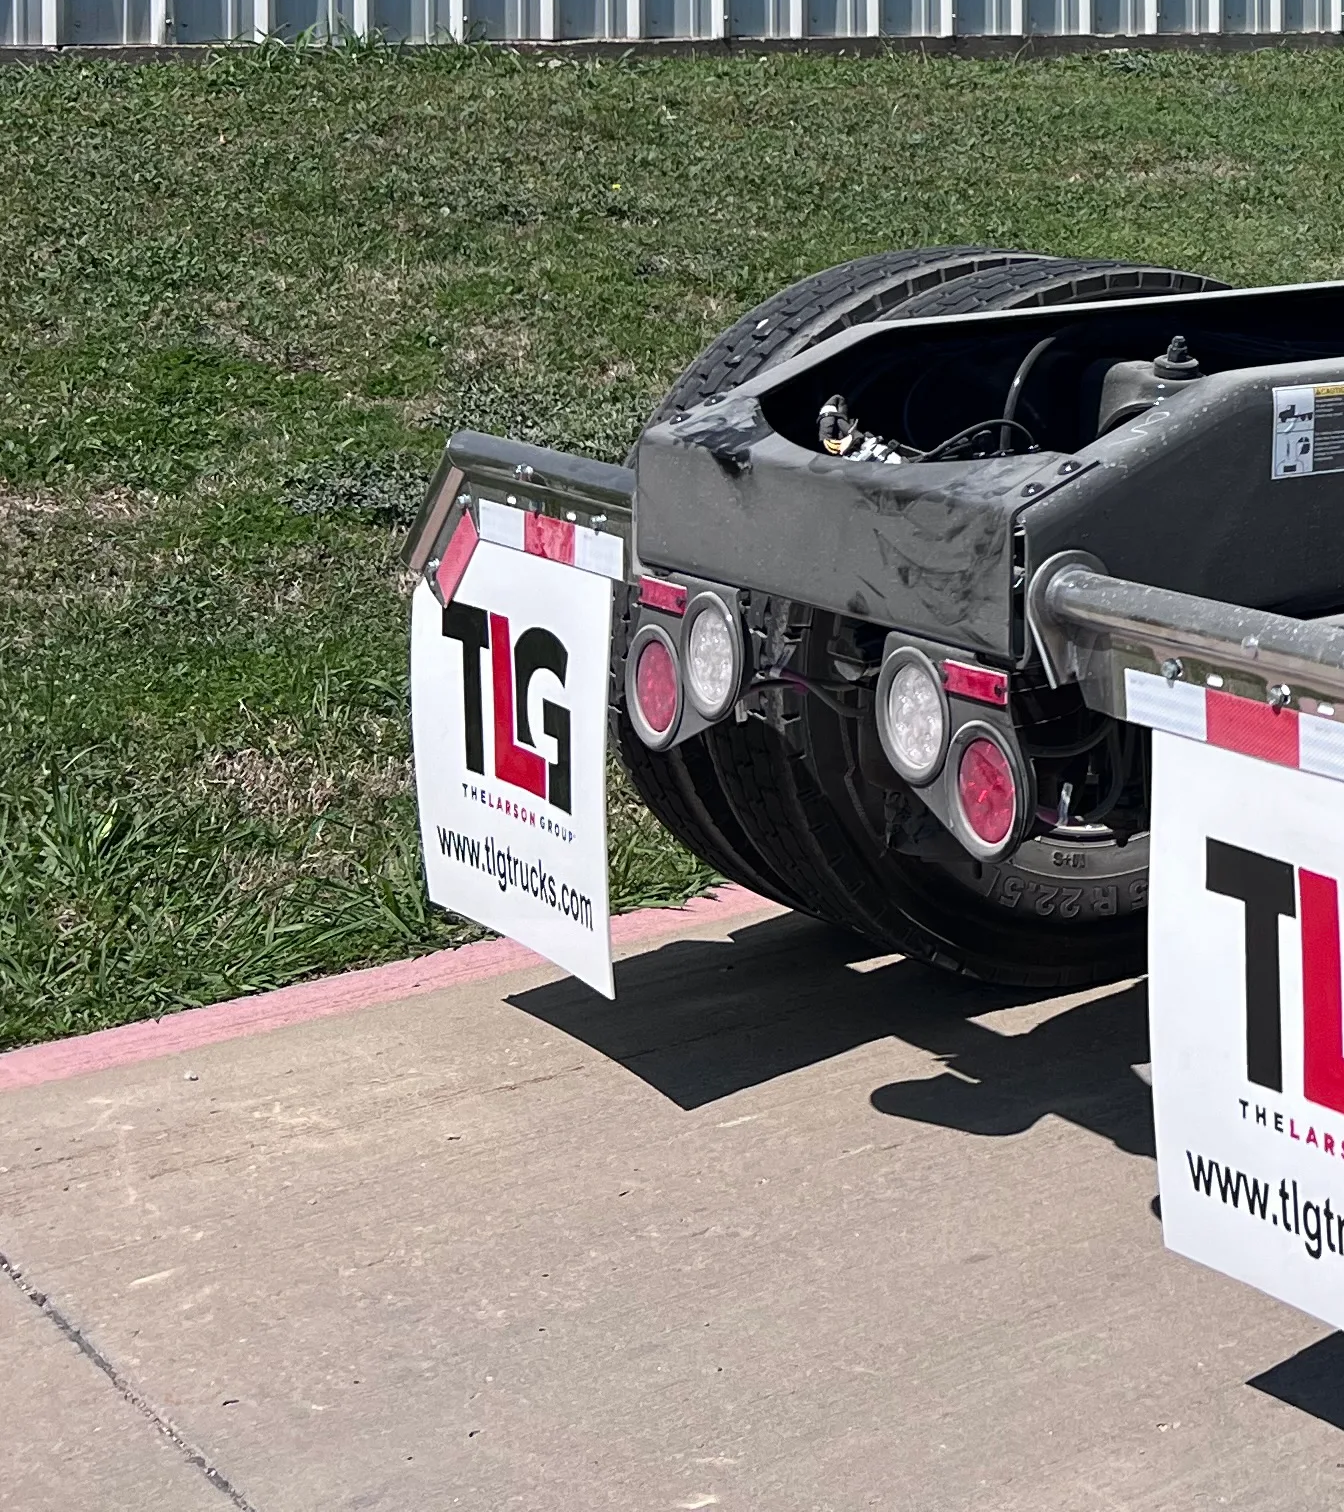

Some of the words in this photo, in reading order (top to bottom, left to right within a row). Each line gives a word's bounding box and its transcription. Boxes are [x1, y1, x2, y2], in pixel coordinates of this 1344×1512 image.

[441, 600, 572, 816] TLG
[539, 815, 573, 844] GROUP
[436, 825, 594, 931] www.tlgtrucks.com
[1052, 851, 1086, 869] M+S
[999, 875, 1083, 919] 22.5
[1091, 885, 1117, 916] R
